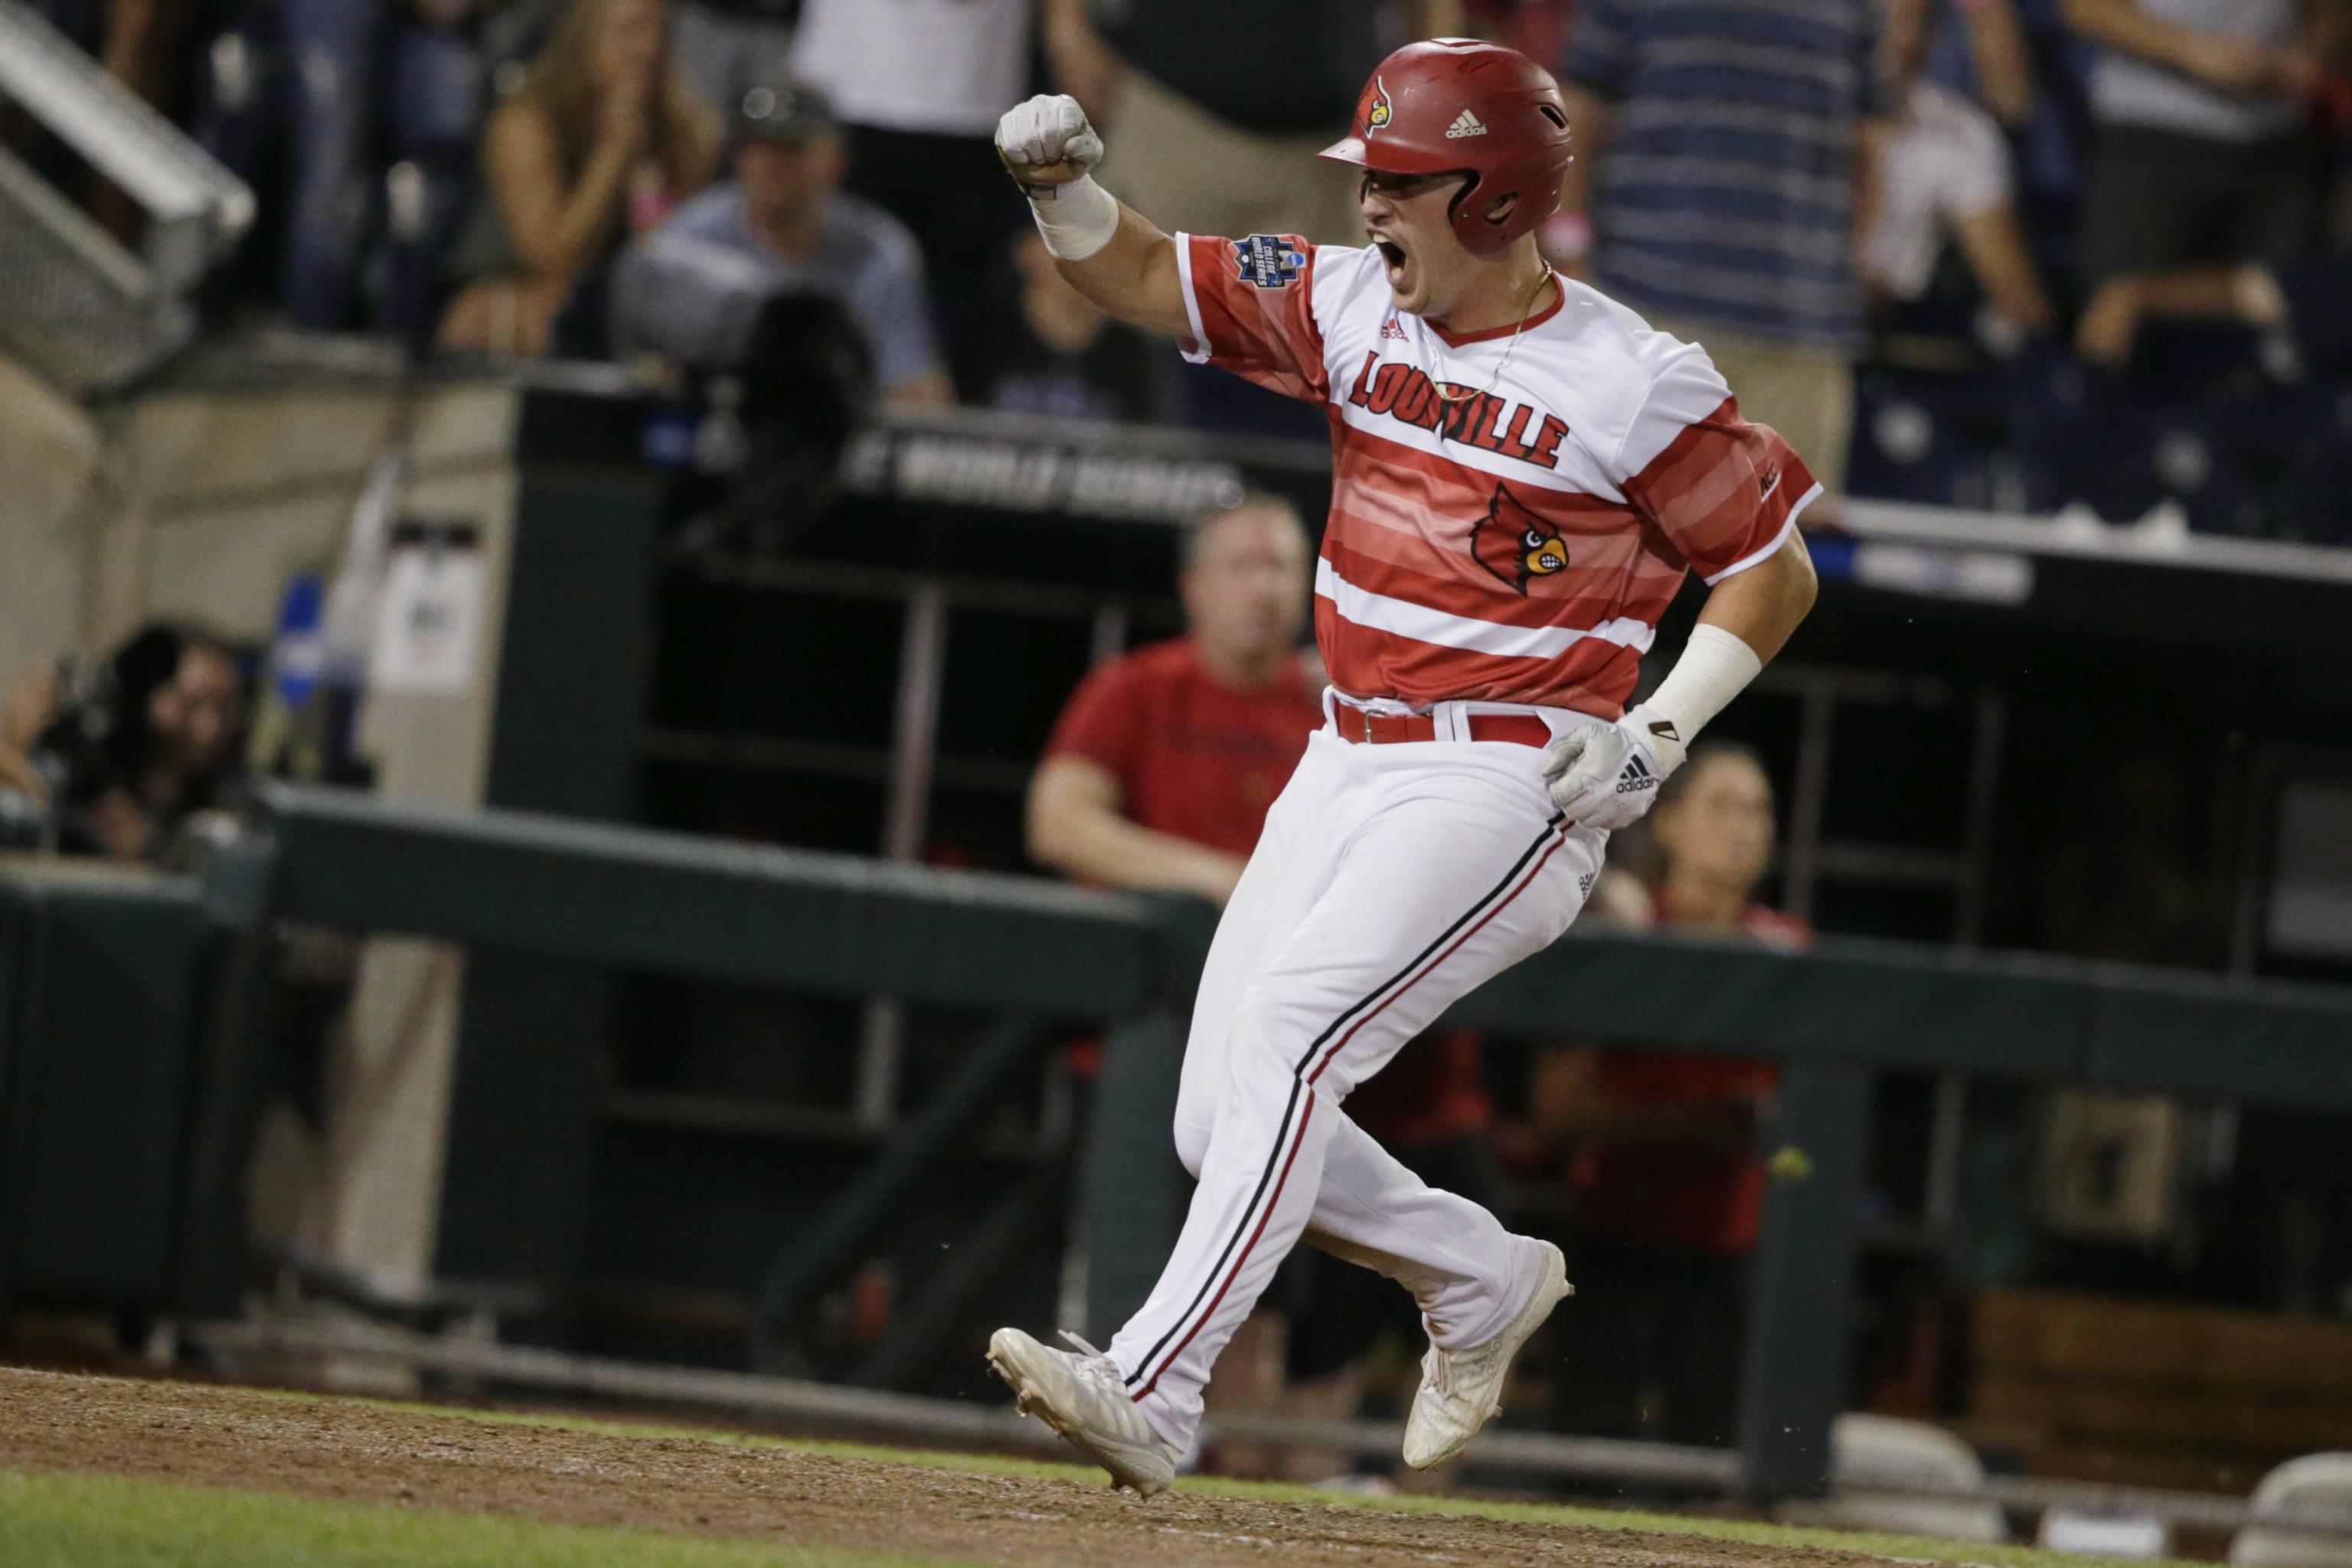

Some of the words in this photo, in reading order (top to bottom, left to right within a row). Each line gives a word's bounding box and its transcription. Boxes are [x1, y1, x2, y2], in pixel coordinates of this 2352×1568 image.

[1446, 125, 1488, 139] adidas
[1252, 237, 1264, 258] WORLD
[1263, 246, 1276, 274] COLLEGE
[1256, 260, 1267, 286] SERIES
[1348, 350, 1570, 470] LOUIVILLE
[1616, 776, 1659, 793] adidas
